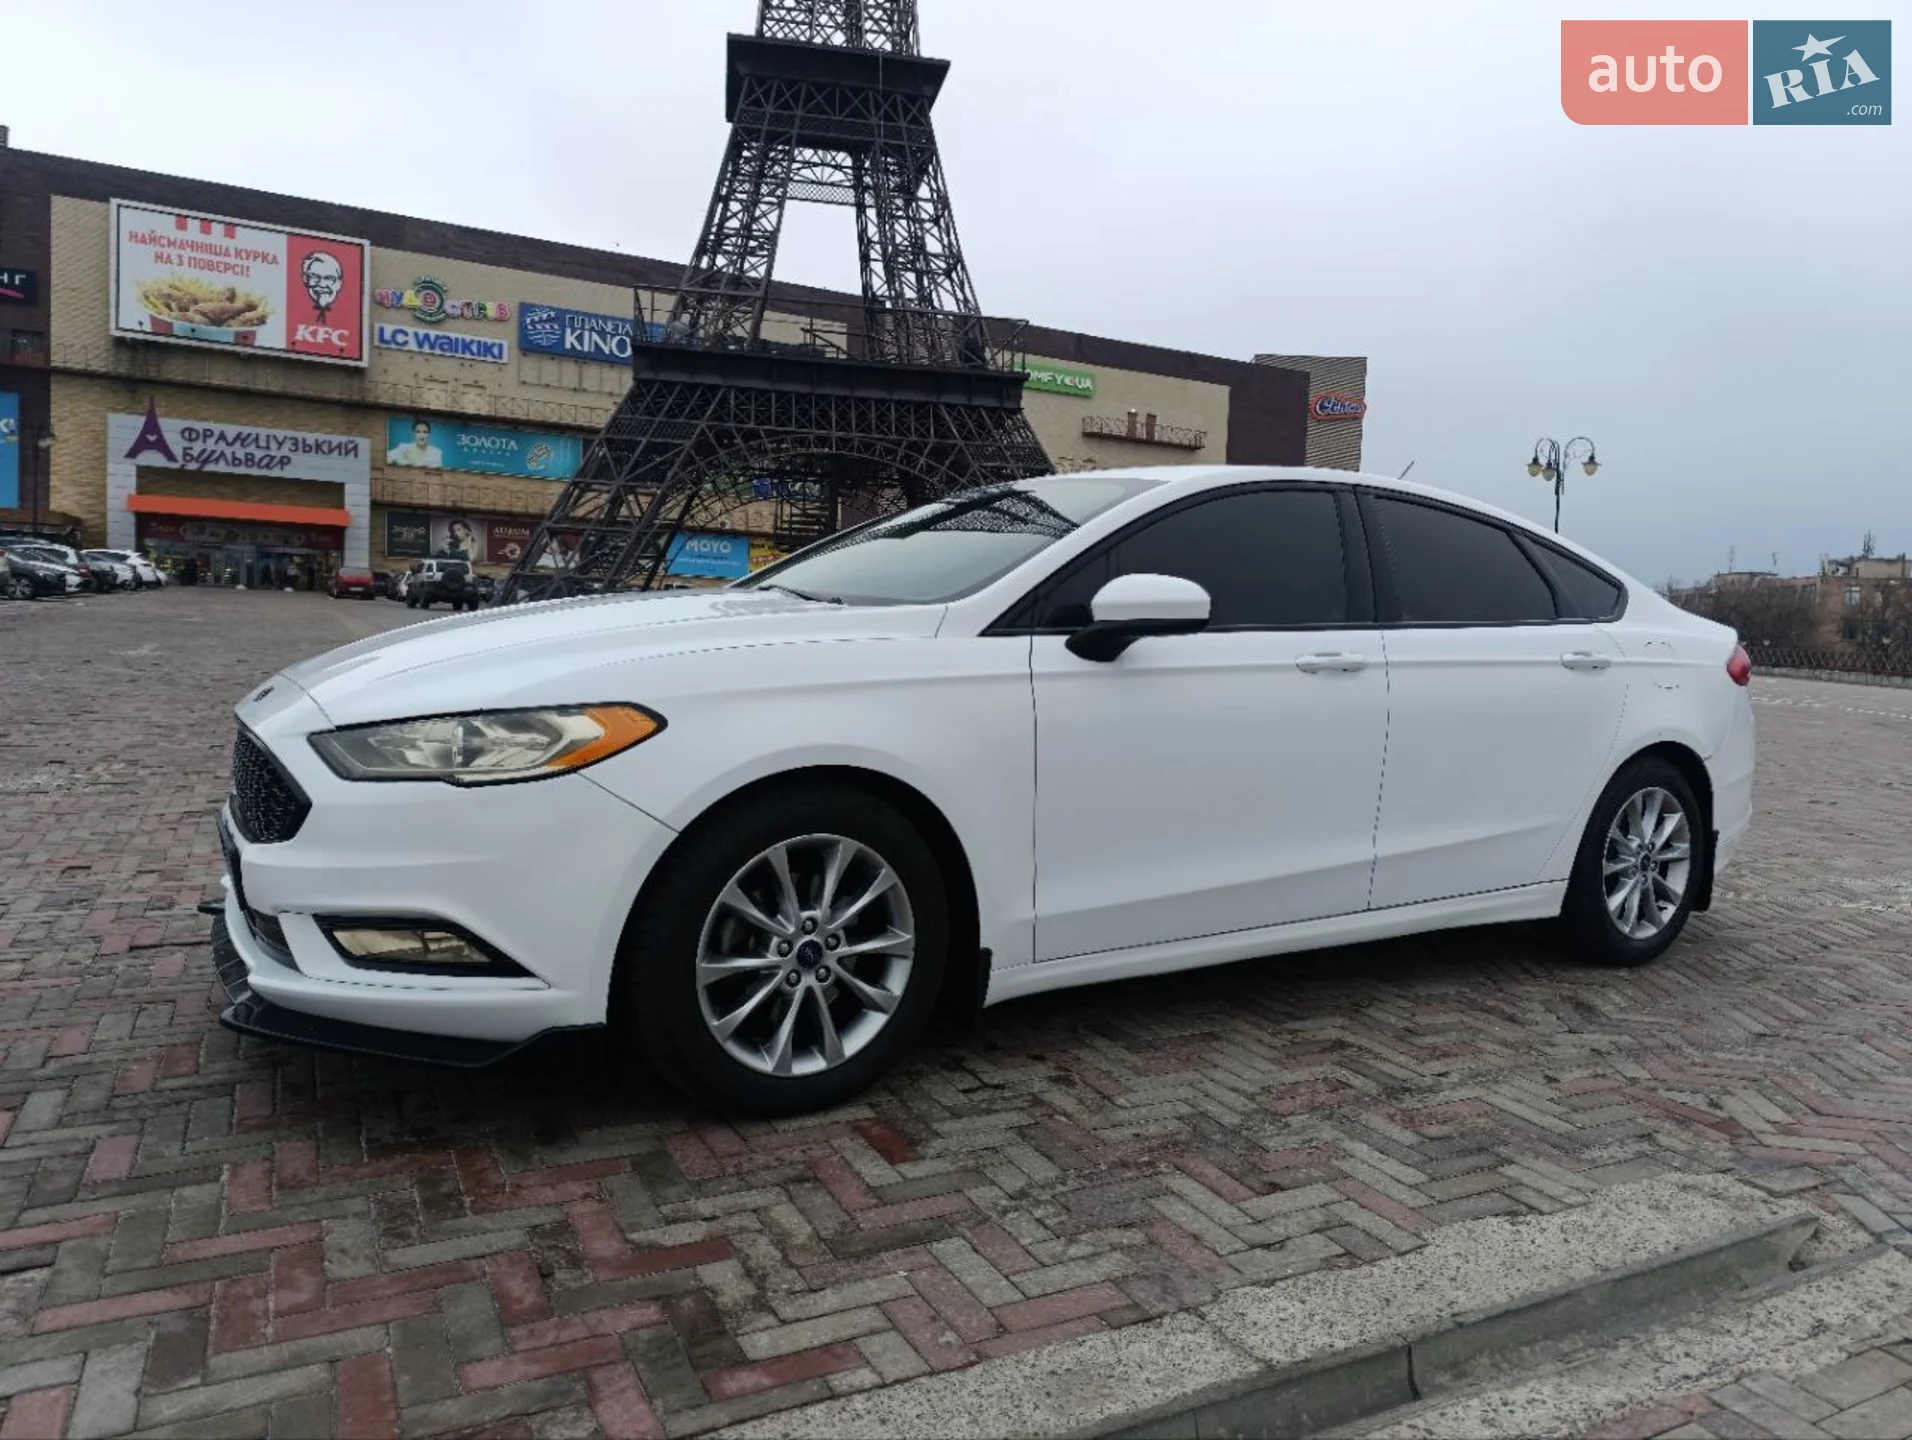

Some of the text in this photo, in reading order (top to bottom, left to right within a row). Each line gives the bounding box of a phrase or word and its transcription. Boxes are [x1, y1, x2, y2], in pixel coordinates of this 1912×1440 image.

[128, 229, 280, 266] НАЙСМАЧНІША КУРКА
[154, 251, 173, 265] НА
[176, 254, 185, 267] 3
[295, 323, 350, 347] KFC
[377, 325, 409, 347] LC
[564, 326, 633, 358] KINO
[179, 426, 360, 459] ФРАНЦУЗЬКИЙ
[457, 433, 519, 452] ЗОЛОТА
